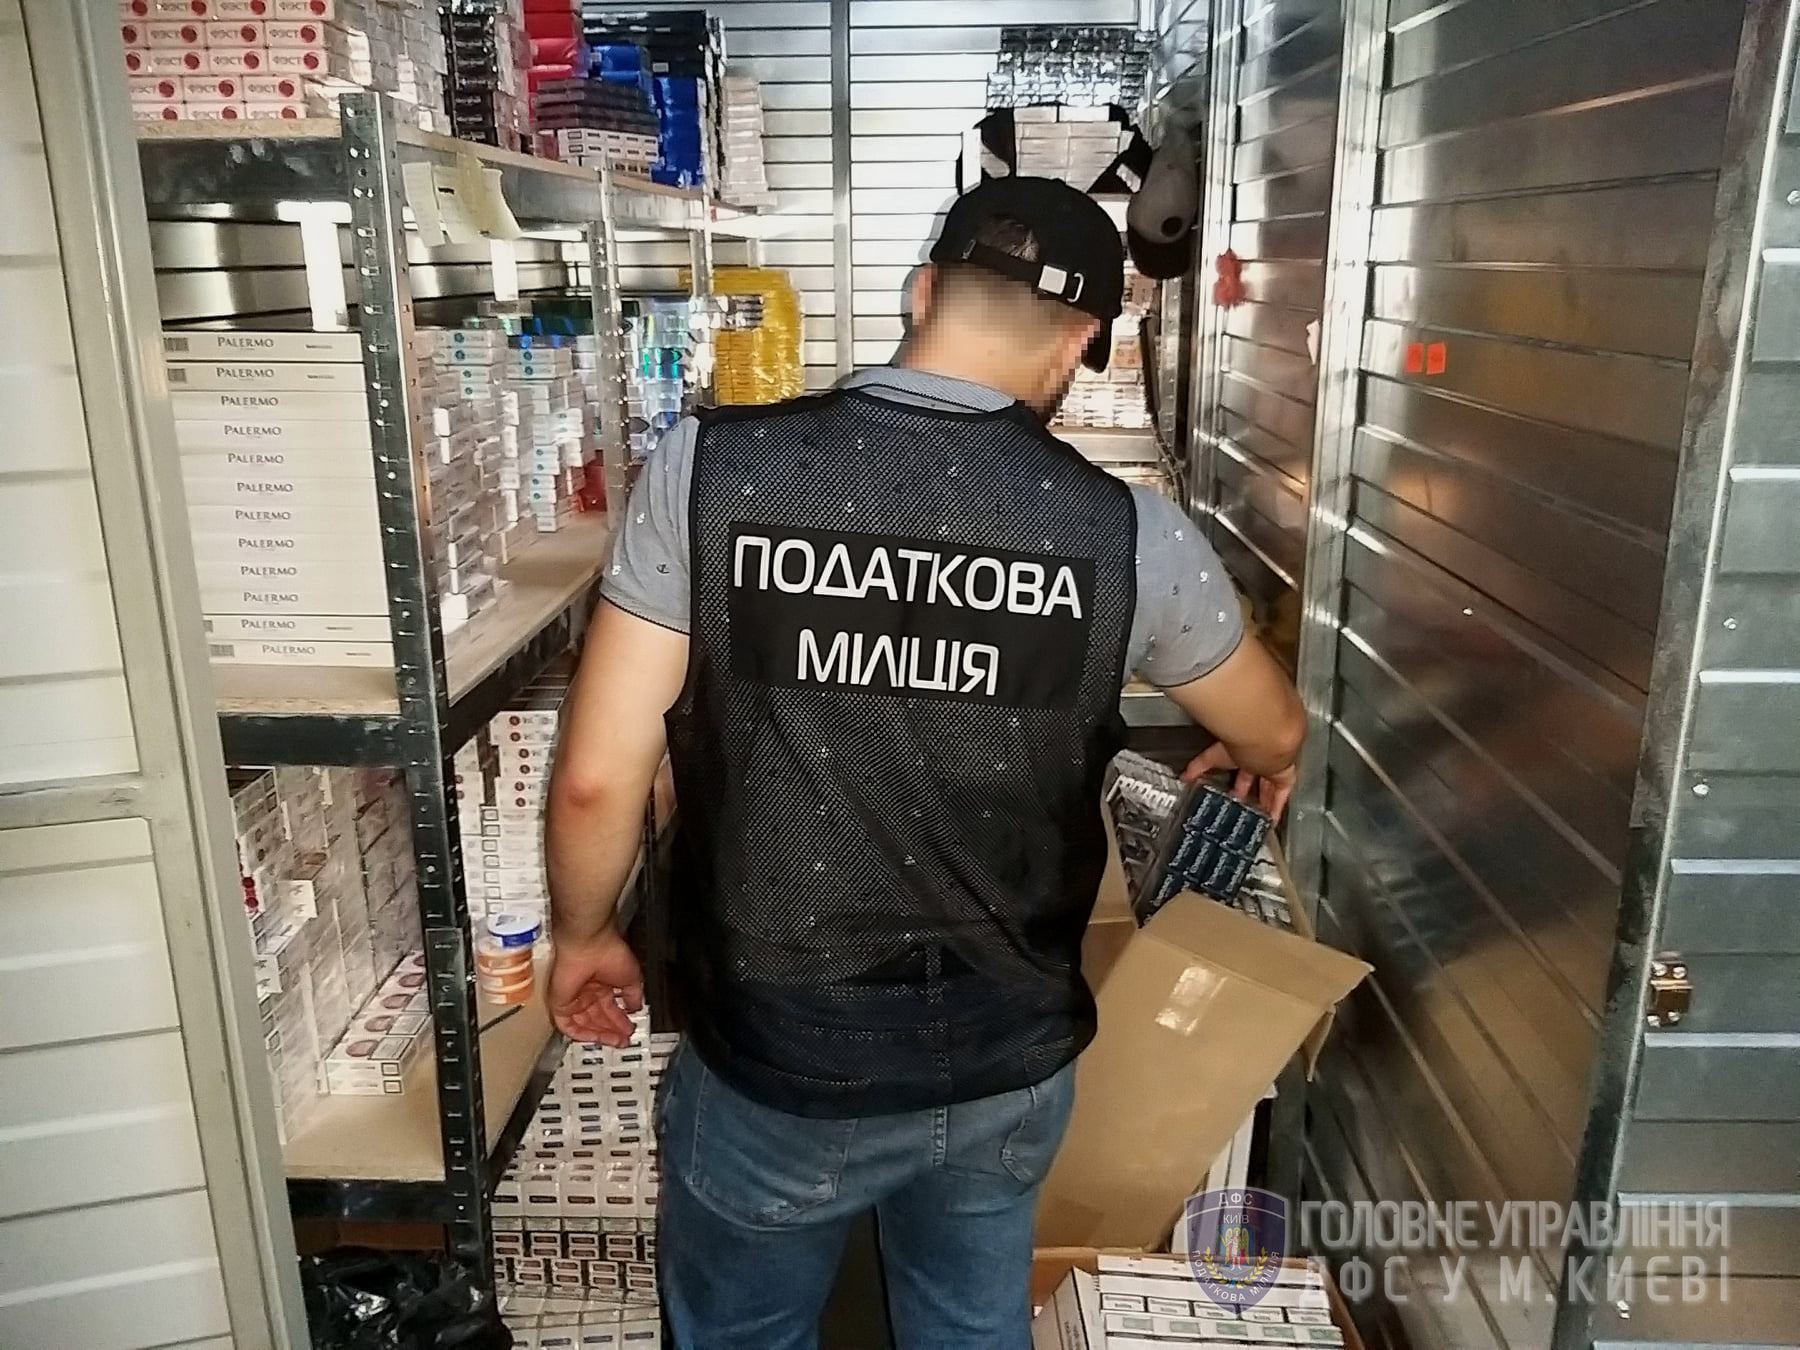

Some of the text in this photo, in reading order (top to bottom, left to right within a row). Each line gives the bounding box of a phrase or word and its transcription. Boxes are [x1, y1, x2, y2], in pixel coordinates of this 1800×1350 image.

[217, 336, 274, 348] PALERMO
[215, 367, 275, 379] PALERMO
[220, 396, 279, 407] PALERMO
[223, 425, 282, 436] PALERMO
[227, 453, 284, 464] PALERMO
[236, 482, 293, 492] PALERMO
[235, 510, 291, 521] PALERMO
[238, 538, 295, 549] PALERMO
[240, 566, 297, 577] PALERMO
[734, 535, 1083, 620] ПОДАТКОВА
[243, 592, 299, 603] PALERMO
[240, 619, 296, 630] PALERMO
[261, 644, 316, 655] PALERMO
[797, 628, 1000, 697] МІЛІЦІЯ
